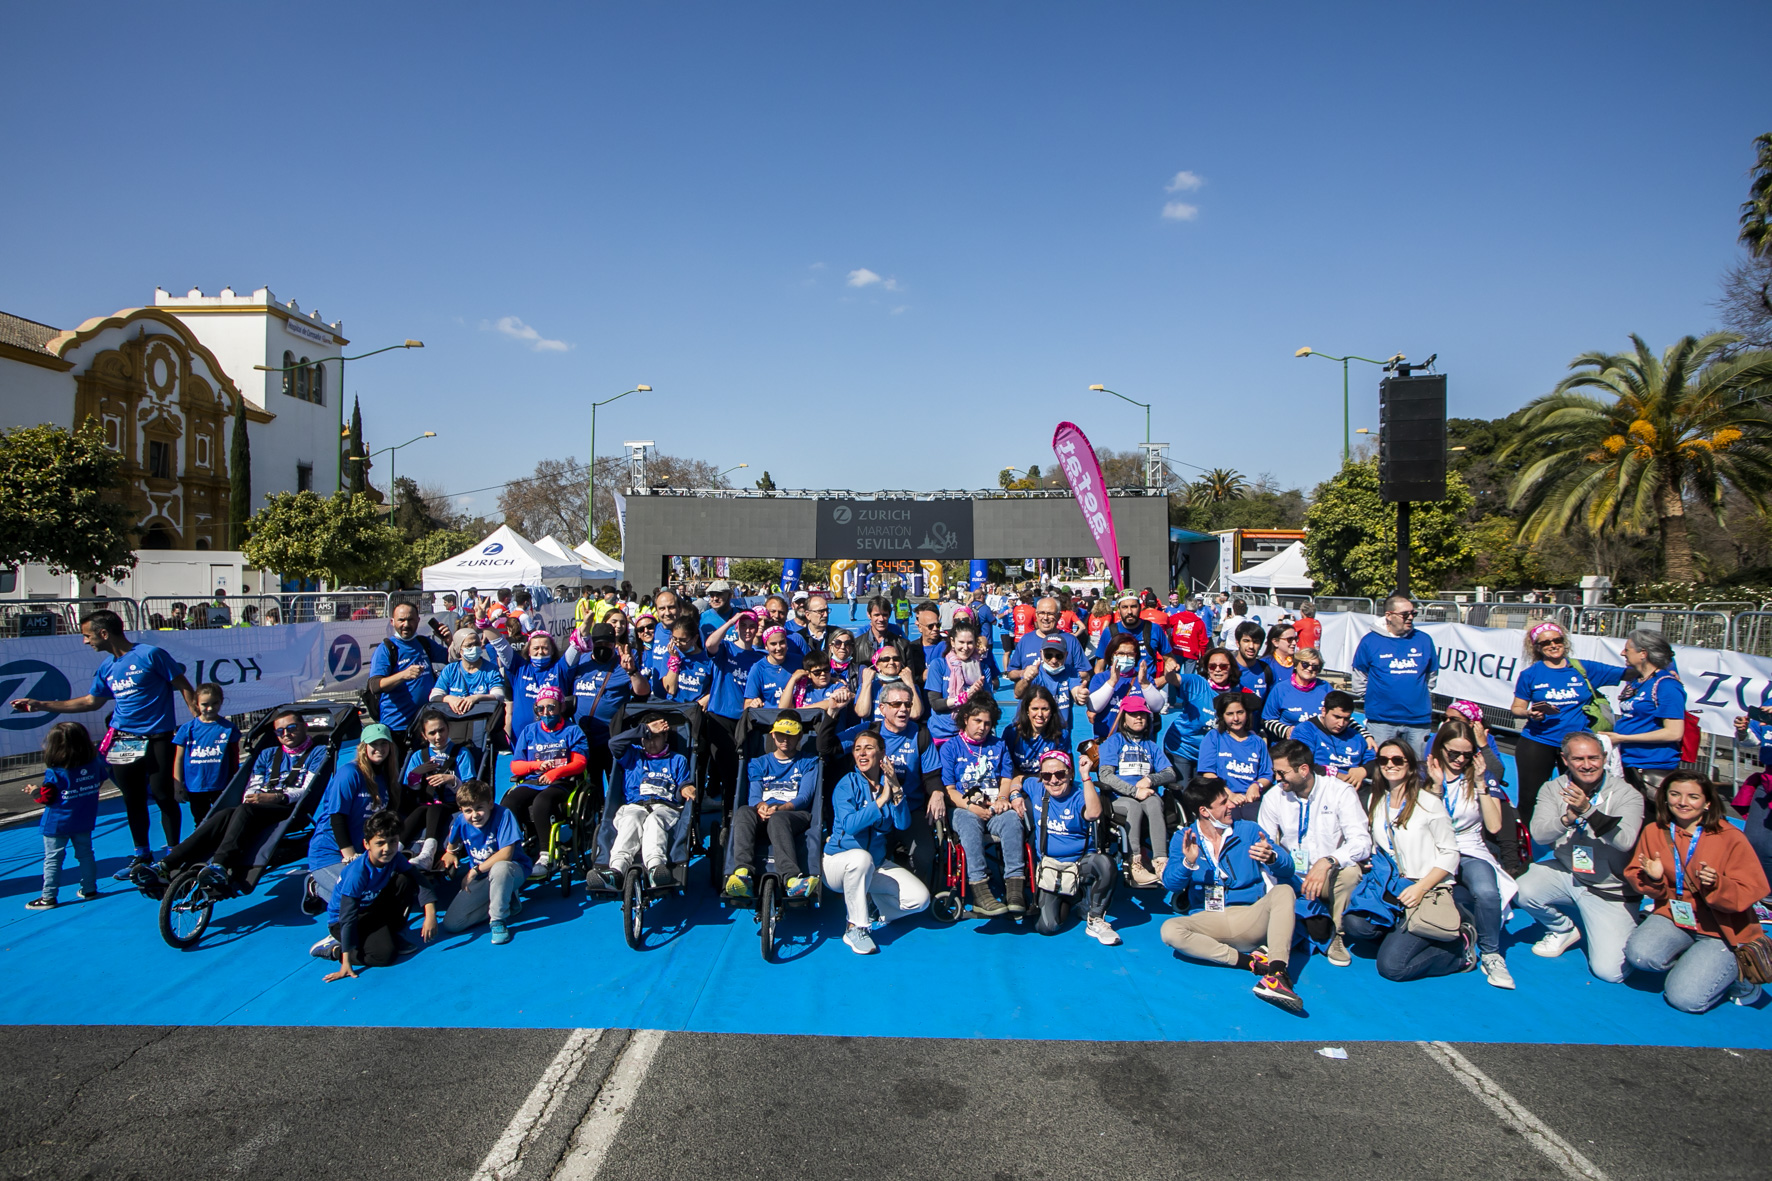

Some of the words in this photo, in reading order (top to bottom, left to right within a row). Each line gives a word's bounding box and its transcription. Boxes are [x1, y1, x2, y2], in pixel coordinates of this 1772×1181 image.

[858, 510, 911, 520] ZURICH
[857, 524, 912, 536] MARATÓN
[856, 538, 912, 550] SEVILLA
[456, 558, 514, 566] ZURICH
[26, 616, 48, 627] AMS
[1437, 646, 1518, 682] URICH
[76, 774, 95, 782] ZURICH
